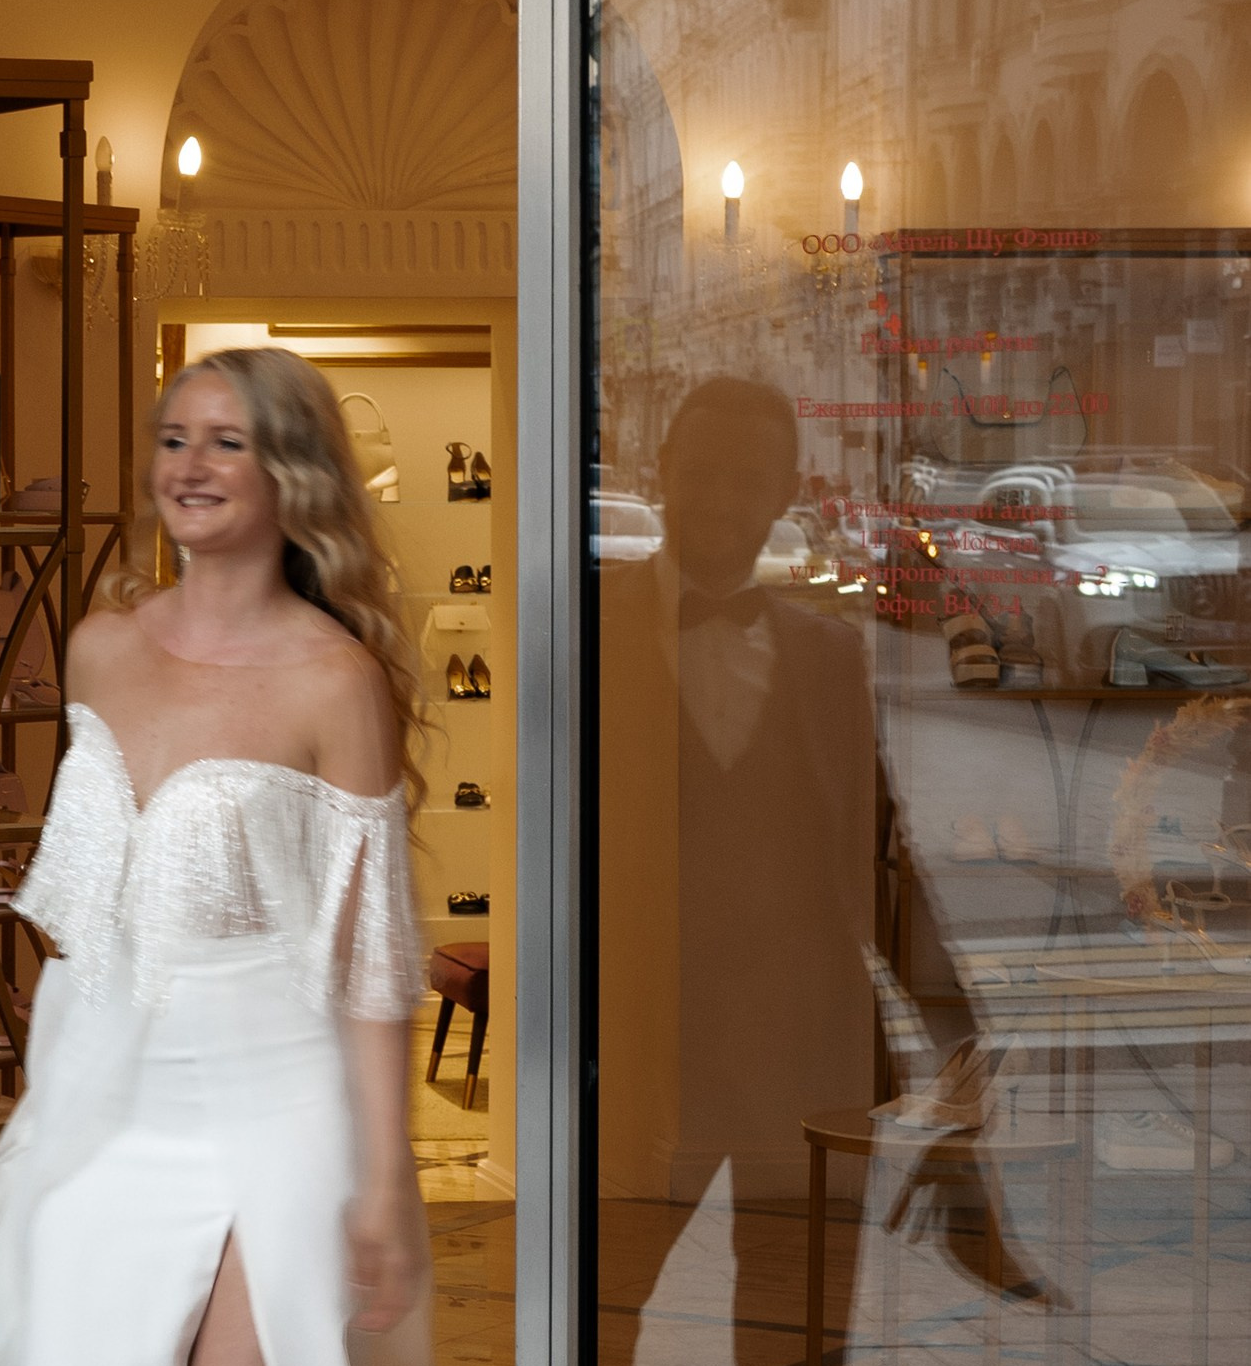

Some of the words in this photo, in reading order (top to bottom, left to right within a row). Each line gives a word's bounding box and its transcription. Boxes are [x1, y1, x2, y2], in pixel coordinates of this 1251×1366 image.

[802, 233, 861, 255] ООО
[965, 228, 1006, 257] Шу
[861, 332, 940, 355] Режим
[797, 397, 926, 420] Ежедневно
[930, 400, 943, 417] с
[1014, 400, 1043, 418] до
[821, 497, 994, 524] Юридический
[874, 593, 939, 620] офис
